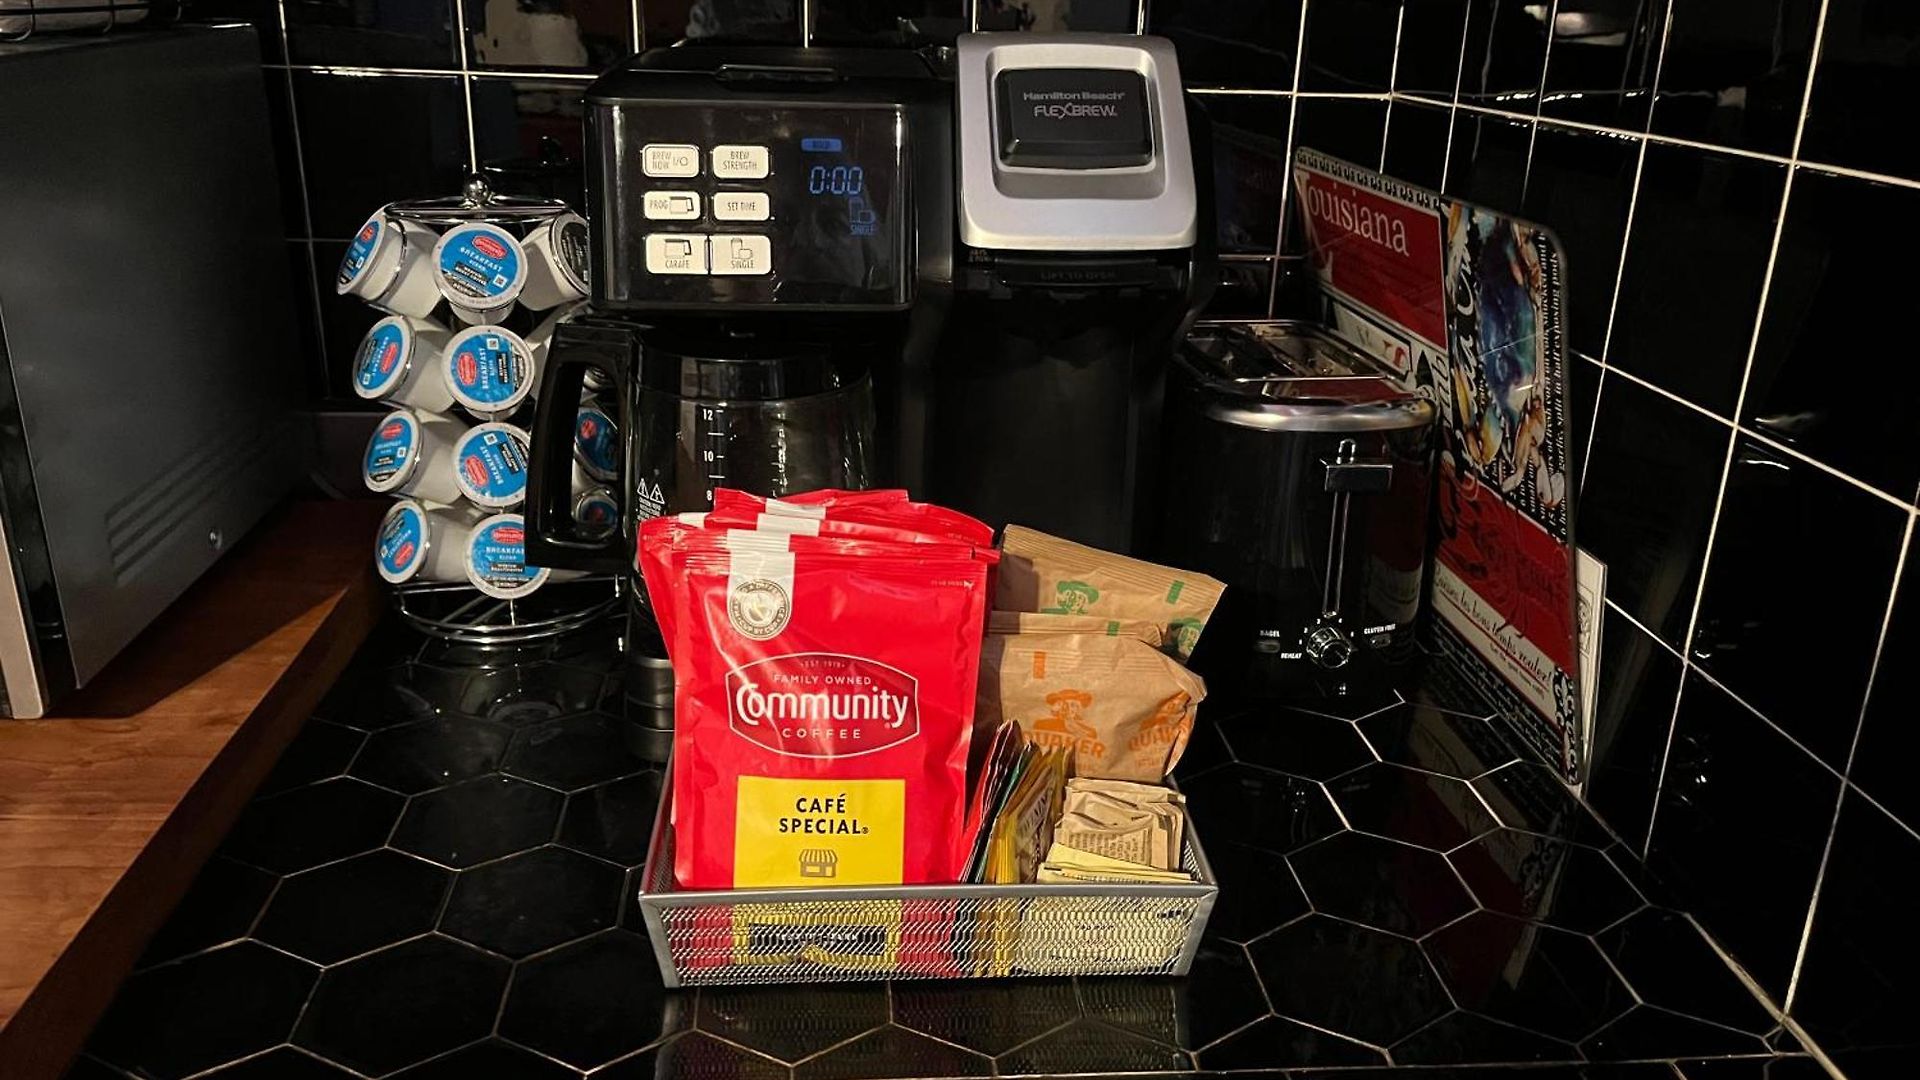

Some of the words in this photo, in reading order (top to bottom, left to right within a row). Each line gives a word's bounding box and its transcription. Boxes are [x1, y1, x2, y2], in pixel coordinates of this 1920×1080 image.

[1023, 91, 1080, 101] Hamilton
[1082, 91, 1121, 101] Beach
[1034, 103, 1115, 119] FLEXBREW
[652, 151, 672, 160] BREW
[730, 151, 750, 160] BREW
[652, 160, 670, 169] NOW
[722, 161, 758, 171] STRENGTH
[809, 166, 863, 194] 0:00
[649, 200, 668, 210] PROG
[727, 202, 739, 211] SET
[740, 202, 756, 211] TIME
[459, 245, 504, 272] BREAKFAST
[665, 259, 690, 269] CARAFE
[731, 259, 754, 269] SINGLE
[1548, 253, 1560, 286] pods
[1550, 288, 1562, 348] exposing
[1553, 349, 1562, 378] half
[703, 409, 714, 421] 12
[703, 450, 714, 462] 10
[479, 445, 505, 485] BREAKFAST
[706, 490, 713, 501] 8
[486, 546, 526, 556] BREAKFA
[773, 674, 820, 686] FAMILY
[824, 674, 872, 686] OWNED
[735, 684, 909, 729] Community
[782, 727, 862, 740] COFFEE
[795, 793, 848, 814] CAFÉ
